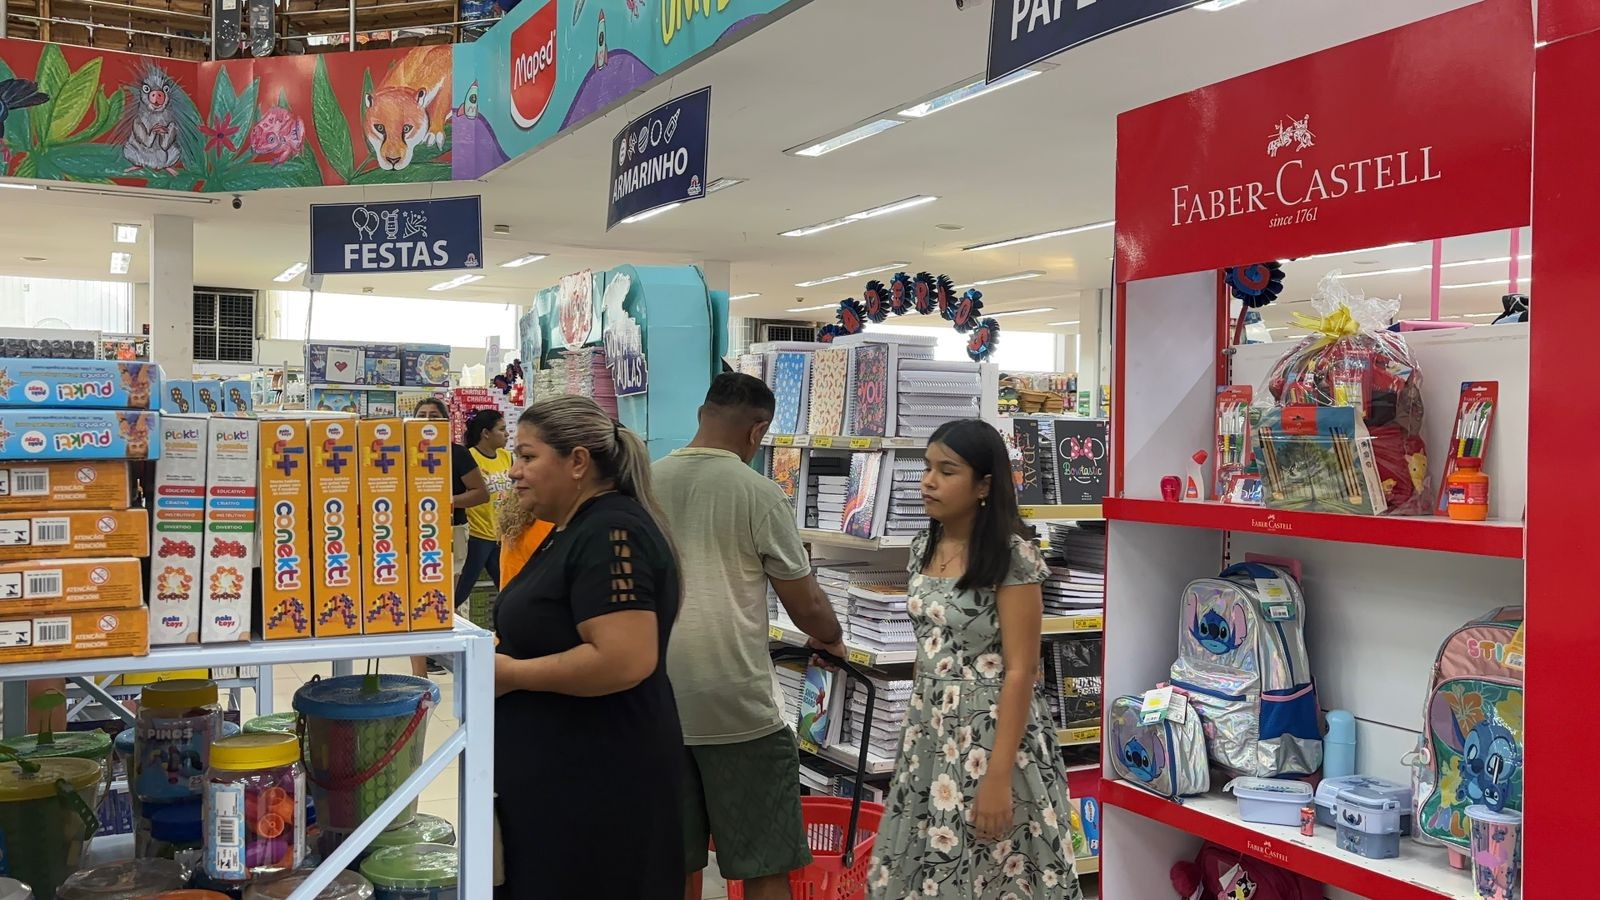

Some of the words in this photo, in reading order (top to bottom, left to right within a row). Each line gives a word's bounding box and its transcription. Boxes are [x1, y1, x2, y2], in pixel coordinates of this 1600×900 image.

[513, 30, 554, 90] Maped
[613, 147, 689, 204] ARMARINHO
[1172, 146, 1442, 227] FABER-CASTELL
[1269, 212, 1293, 229] since
[1296, 206, 1318, 224] 1761
[344, 240, 449, 270] FESTAS
[617, 356, 642, 390] AULAS
[147, 728, 193, 740] PINOS
